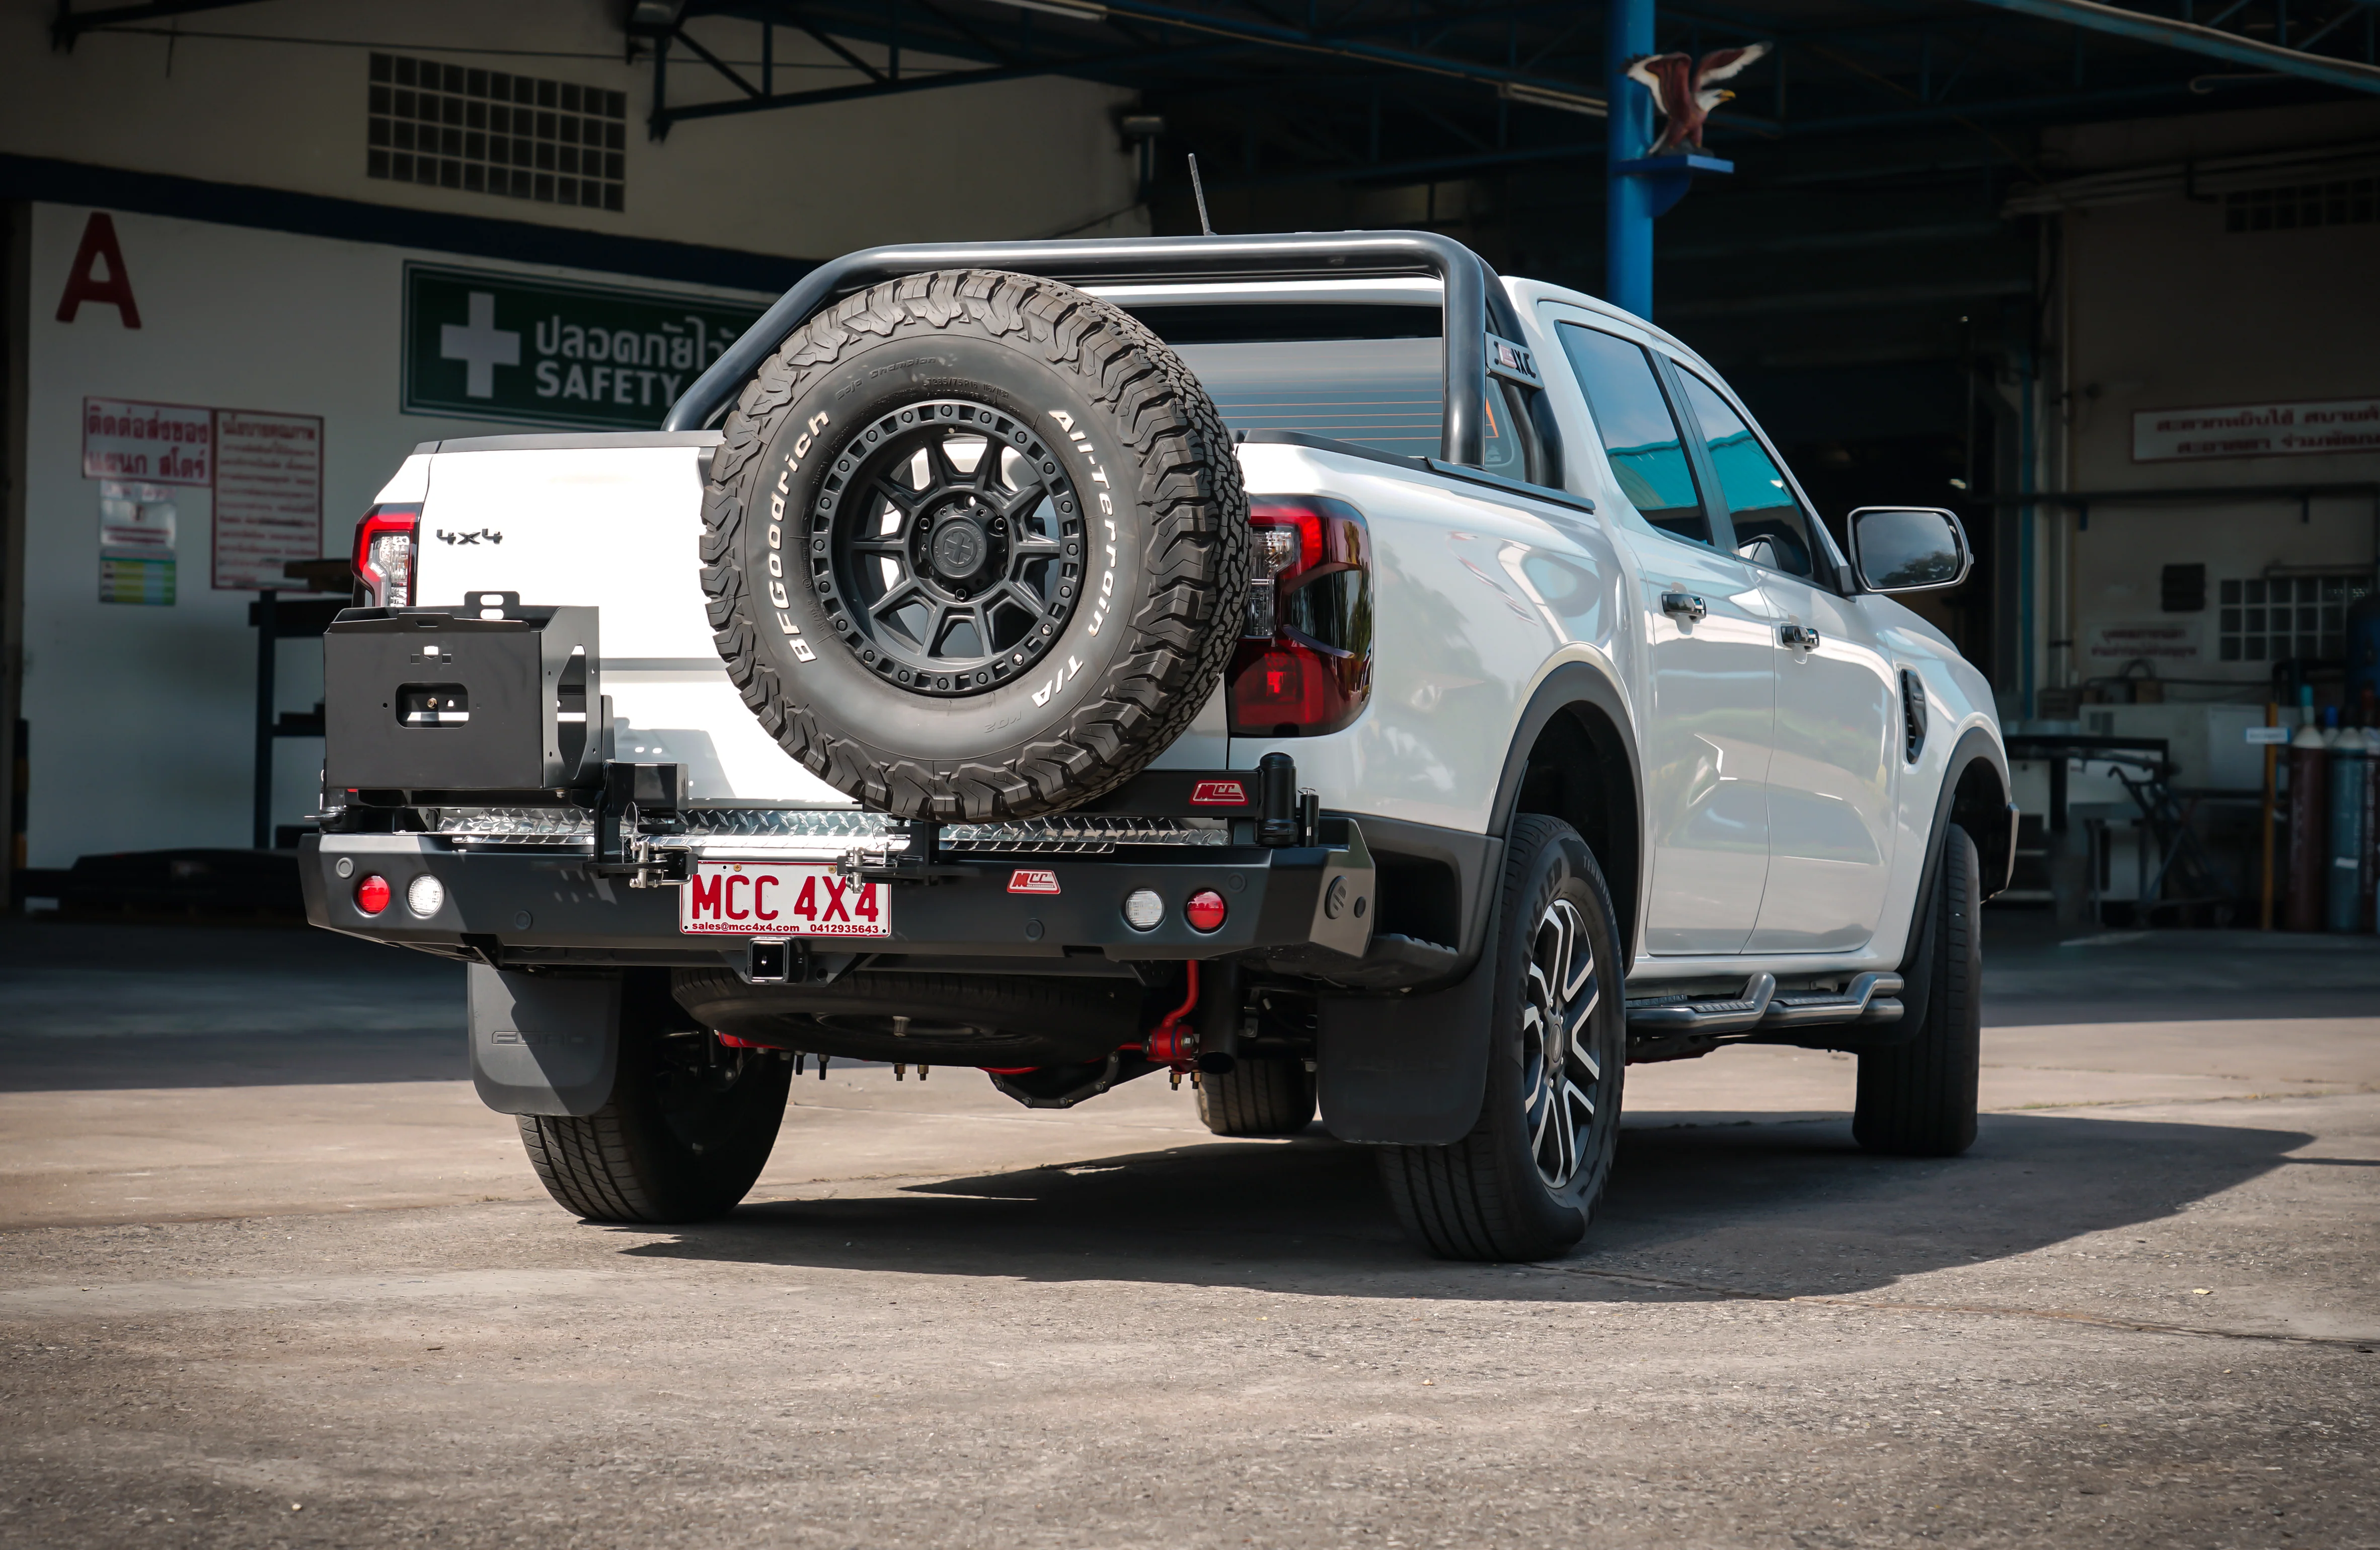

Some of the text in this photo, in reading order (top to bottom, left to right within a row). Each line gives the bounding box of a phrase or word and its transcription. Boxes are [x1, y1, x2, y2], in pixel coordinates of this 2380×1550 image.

[55, 211, 141, 330] A
[535, 360, 682, 407] SAFETY
[769, 411, 829, 662] BFGoodrich
[1031, 410, 1118, 708] All-Terrain T/A
[692, 874, 879, 922] MCC 4X4
[1012, 872, 1054, 888] MCC
[692, 922, 879, 934] sales@mcc4x4.com 0412935643
